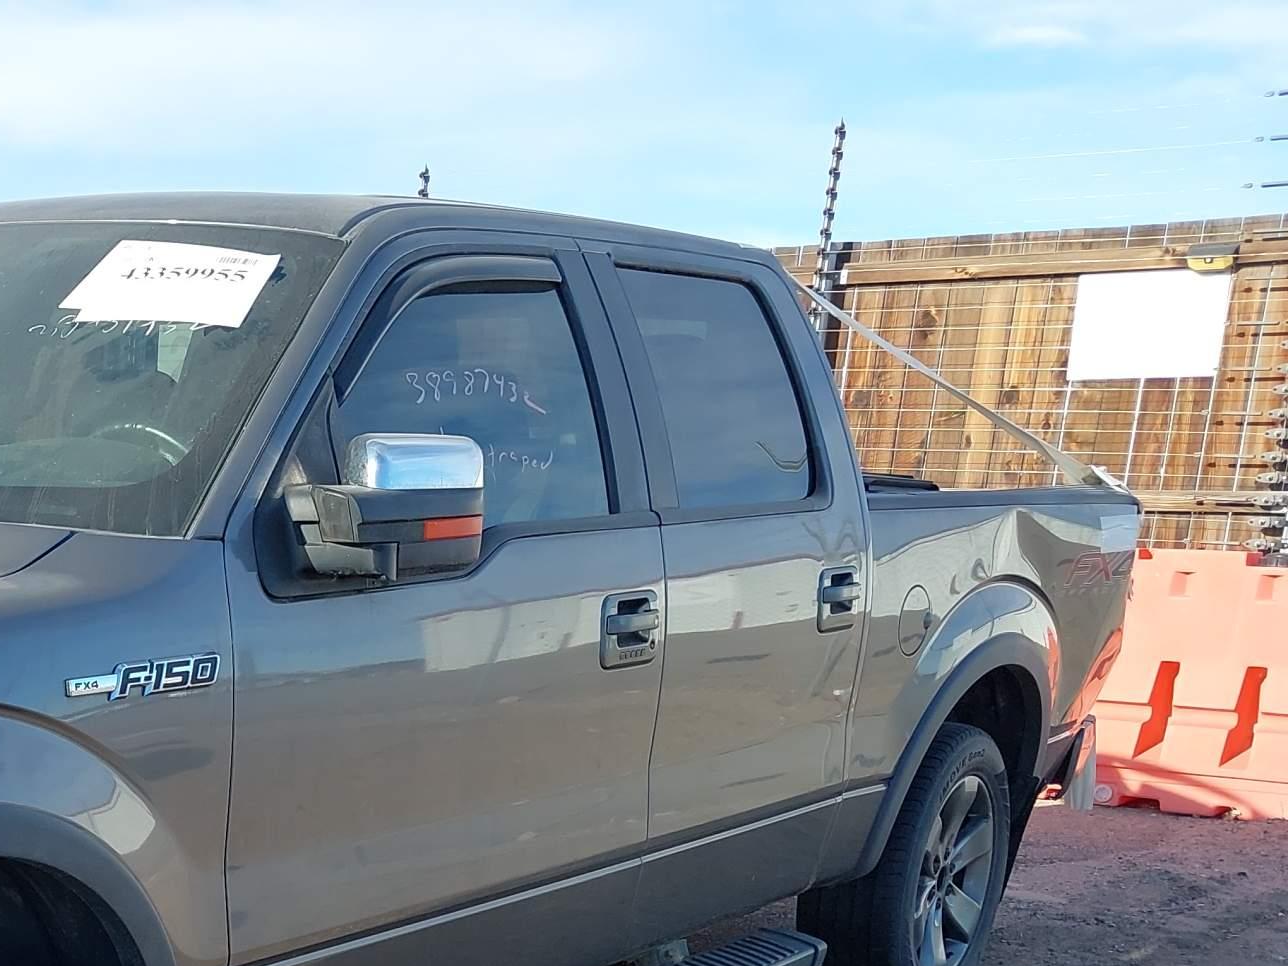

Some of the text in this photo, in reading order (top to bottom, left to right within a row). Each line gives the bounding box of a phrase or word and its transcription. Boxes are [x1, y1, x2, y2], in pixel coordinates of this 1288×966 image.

[120, 266, 249, 282] 43359955
[74, 653, 221, 697] FX4 F-150
